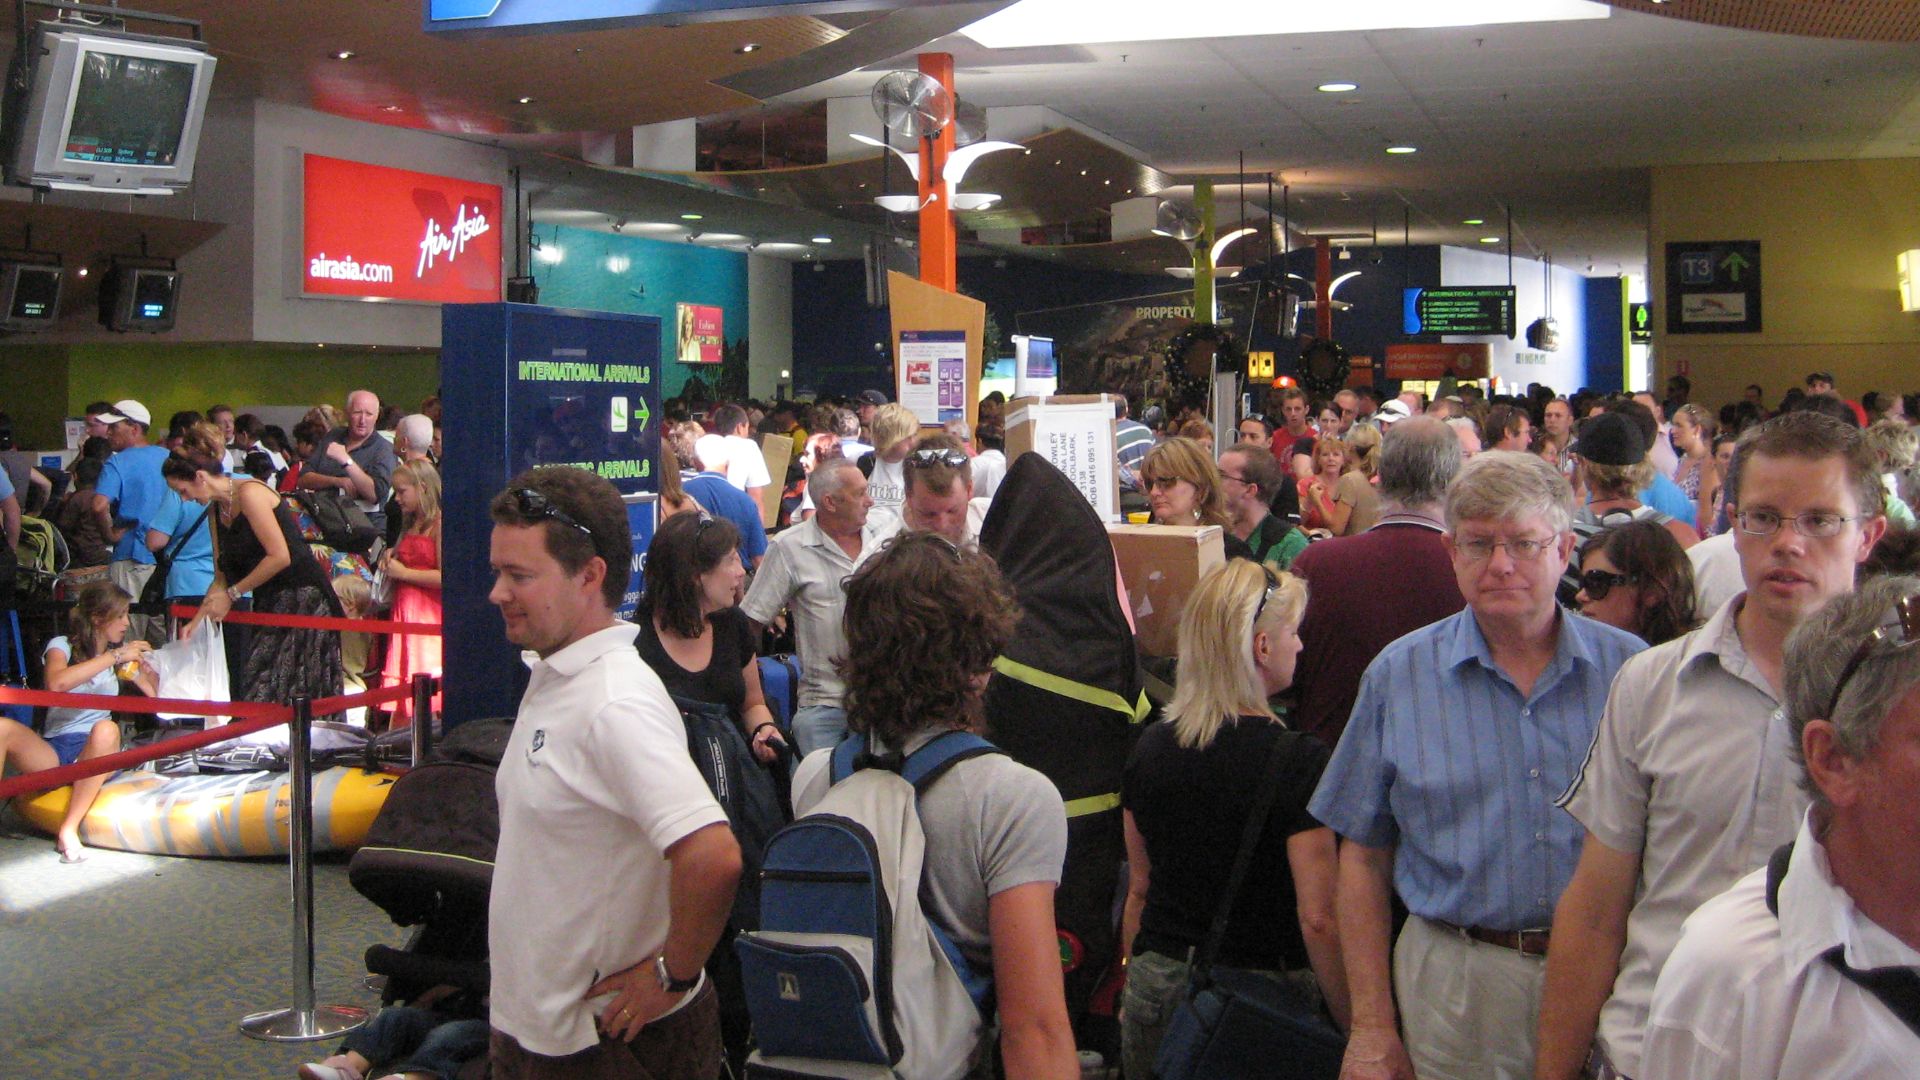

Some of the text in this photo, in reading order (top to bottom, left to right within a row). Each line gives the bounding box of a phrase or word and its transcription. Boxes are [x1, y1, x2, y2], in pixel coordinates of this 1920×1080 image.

[417, 203, 490, 278] Air Asia
[310, 252, 393, 283] airasia.com
[1684, 259, 1710, 276] T3
[1136, 306, 1196, 319] PROPERTY
[518, 361, 650, 384] INTERNATIONAL ARRIVALS
[1050, 432, 1058, 467] OWLEY
[1069, 433, 1077, 484] OOLBARK,
[597, 459, 650, 479] ARRIVALS
[1087, 431, 1097, 506] MOB 0416 095 131
[1079, 471, 1087, 490] 3138
[631, 552, 648, 573] NG
